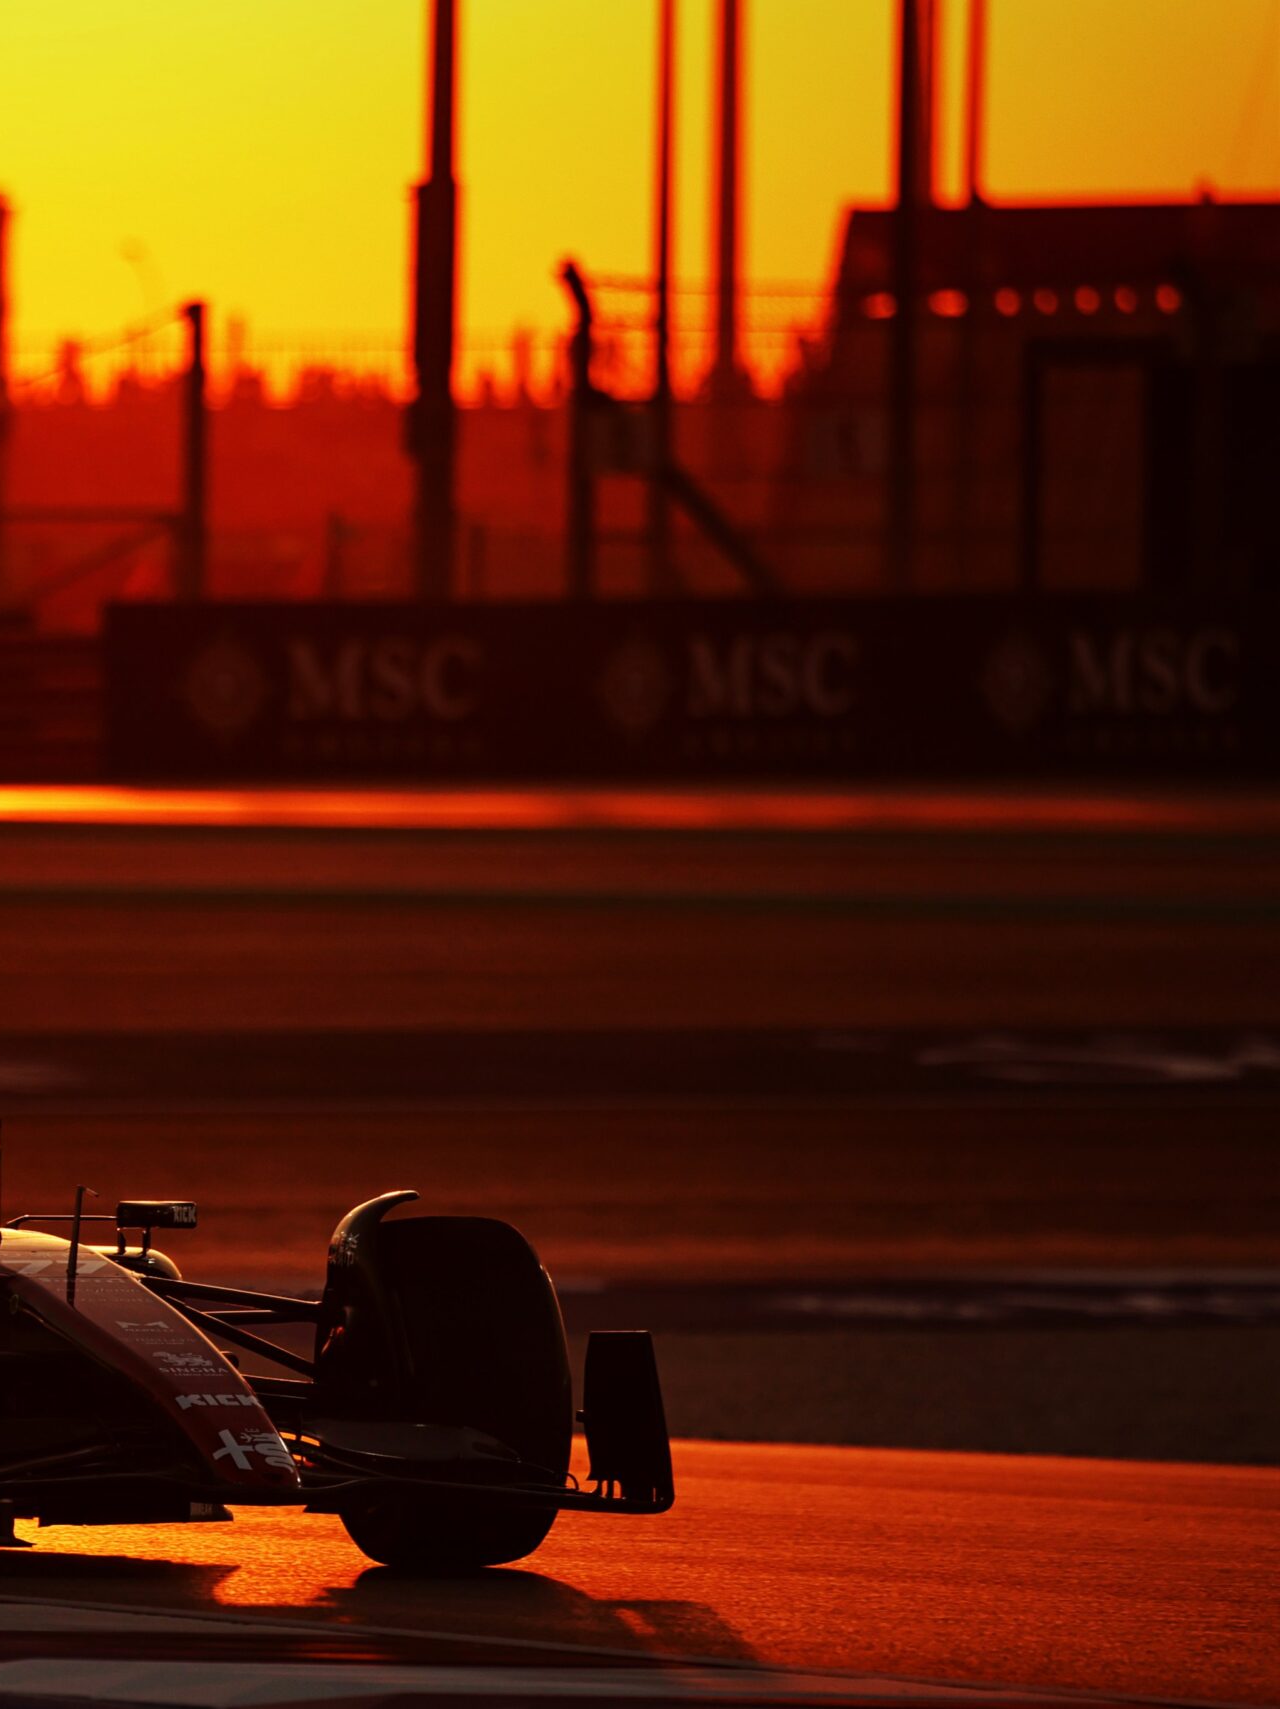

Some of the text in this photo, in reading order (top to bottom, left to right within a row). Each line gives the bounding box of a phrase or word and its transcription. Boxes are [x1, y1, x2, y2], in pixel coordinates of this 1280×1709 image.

[287, 636, 483, 719] MSC
[685, 631, 858, 718] MSC
[1068, 629, 1237, 715] MSC
[173, 1206, 196, 1224] KICK
